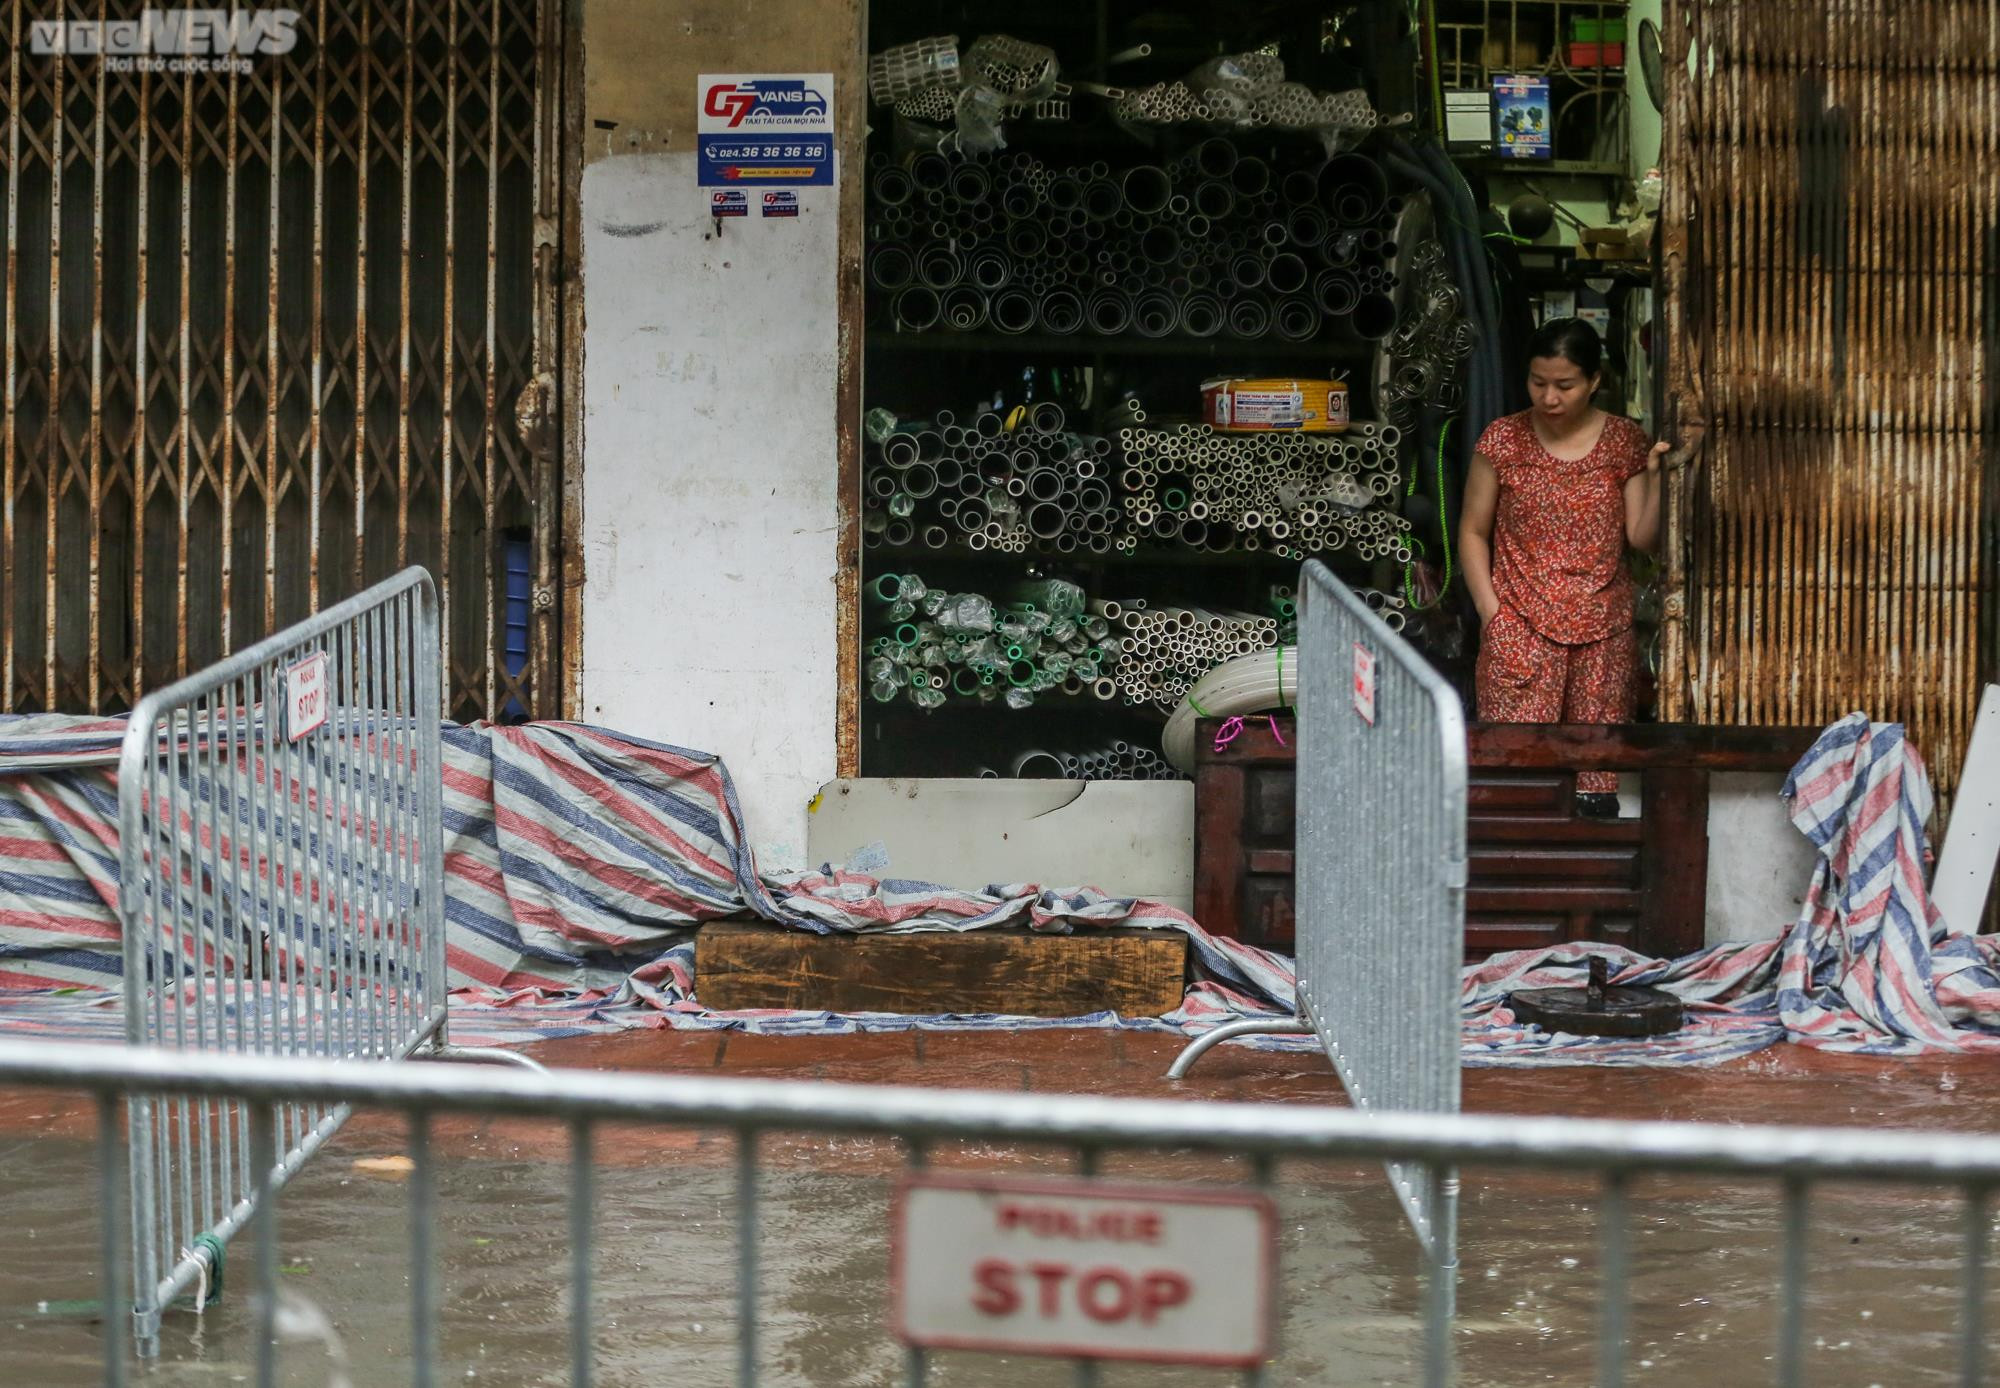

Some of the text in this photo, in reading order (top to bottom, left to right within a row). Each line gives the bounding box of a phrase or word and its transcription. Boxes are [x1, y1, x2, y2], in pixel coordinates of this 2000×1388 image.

[704, 84, 755, 127] G7
[759, 91, 803, 102] VANS
[763, 147, 780, 157] 36
[784, 147, 801, 157] 36
[804, 147, 822, 157] 36
[970, 1256, 1193, 1326] STOP
